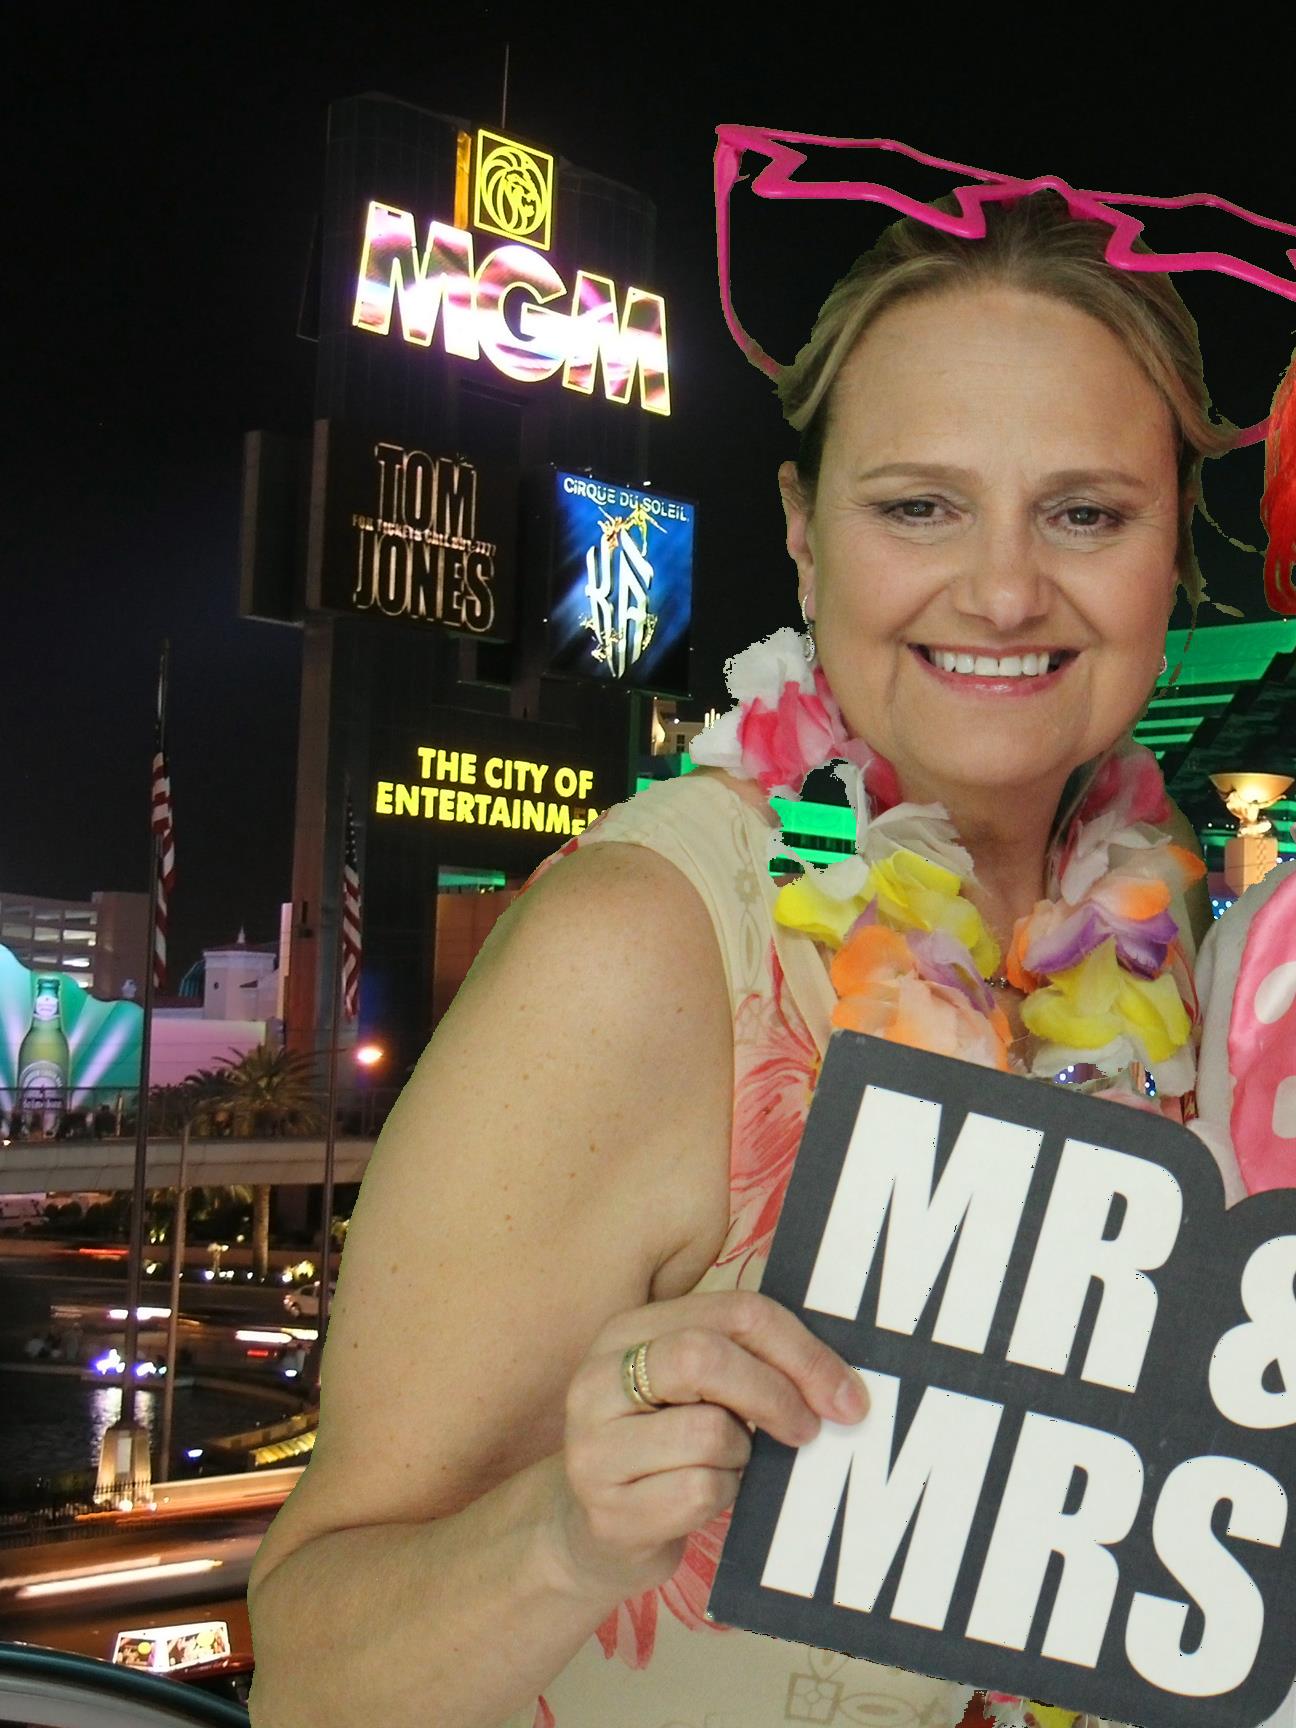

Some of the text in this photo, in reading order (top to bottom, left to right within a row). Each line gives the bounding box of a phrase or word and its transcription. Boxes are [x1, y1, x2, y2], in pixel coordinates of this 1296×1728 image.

[353, 201, 671, 416] MGM
[374, 442, 477, 540] TOM
[377, 518, 422, 541] TICKETS
[424, 528, 450, 548] CALL
[353, 529, 495, 632] JONES
[418, 746, 593, 799] THE CITY OF
[803, 1084, 1183, 1393] MR
[760, 1363, 1288, 1697] MRS
